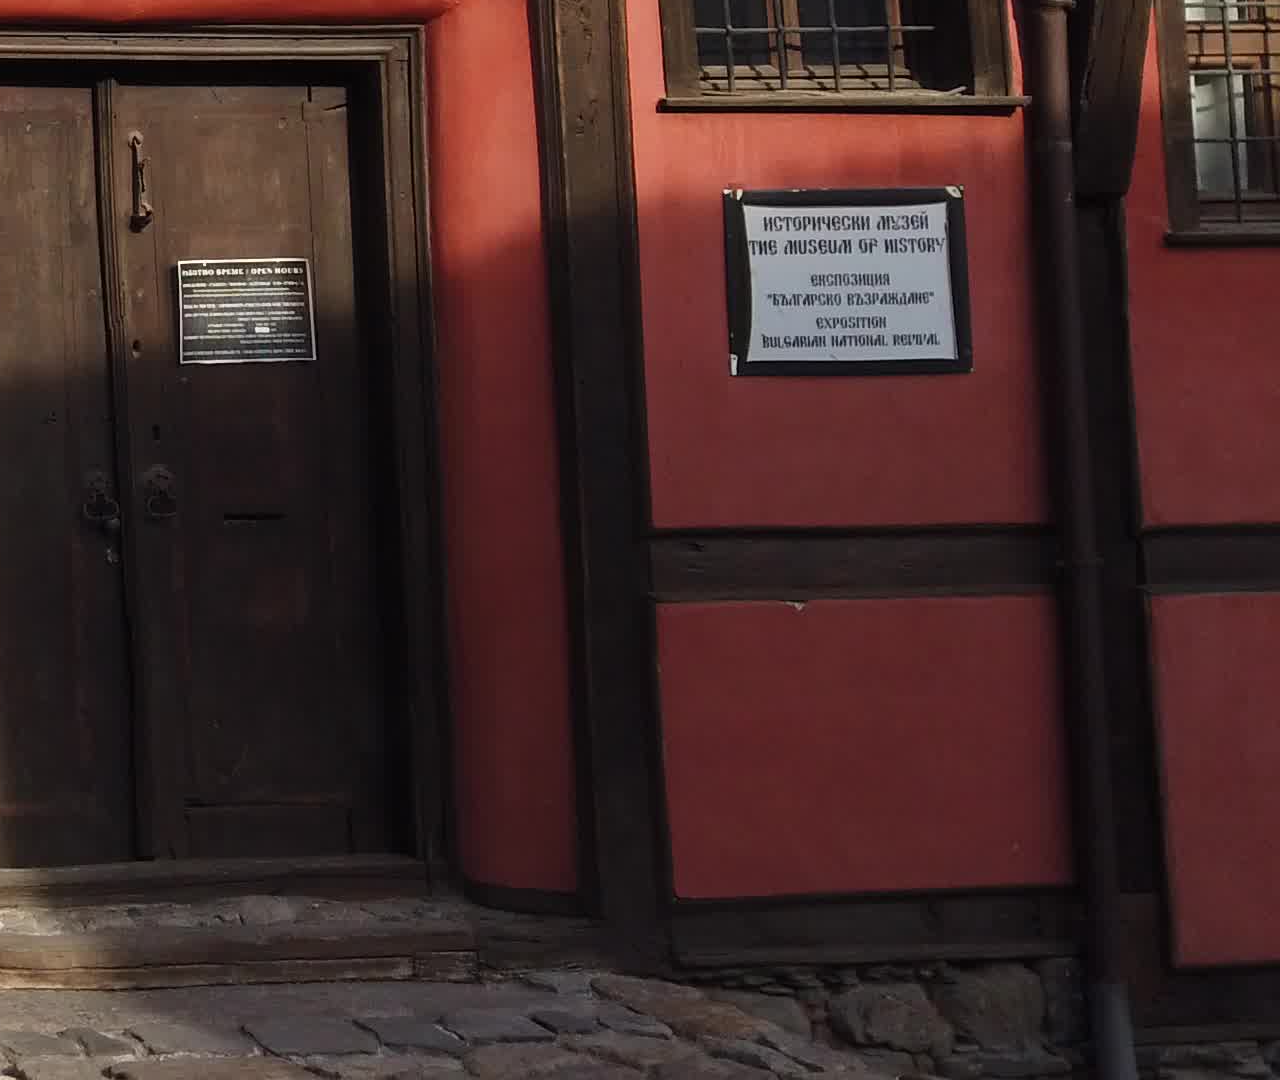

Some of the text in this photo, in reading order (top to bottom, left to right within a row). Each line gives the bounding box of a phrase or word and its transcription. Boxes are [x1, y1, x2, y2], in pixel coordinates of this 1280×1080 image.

[763, 215, 870, 232] ИСТОРИЧЕСКИ
[749, 237, 945, 256] THE MUSEUM OF HISTORY
[810, 273, 890, 288] ЕКСПОЗИЦИЯ
[767, 291, 934, 307] "БЪЛГАРСКО ВЪЗРАЖДАНЕ"
[816, 316, 887, 330] EXPOSITION
[761, 333, 941, 349] BULGARIAN NATIONAL REVIVAL
